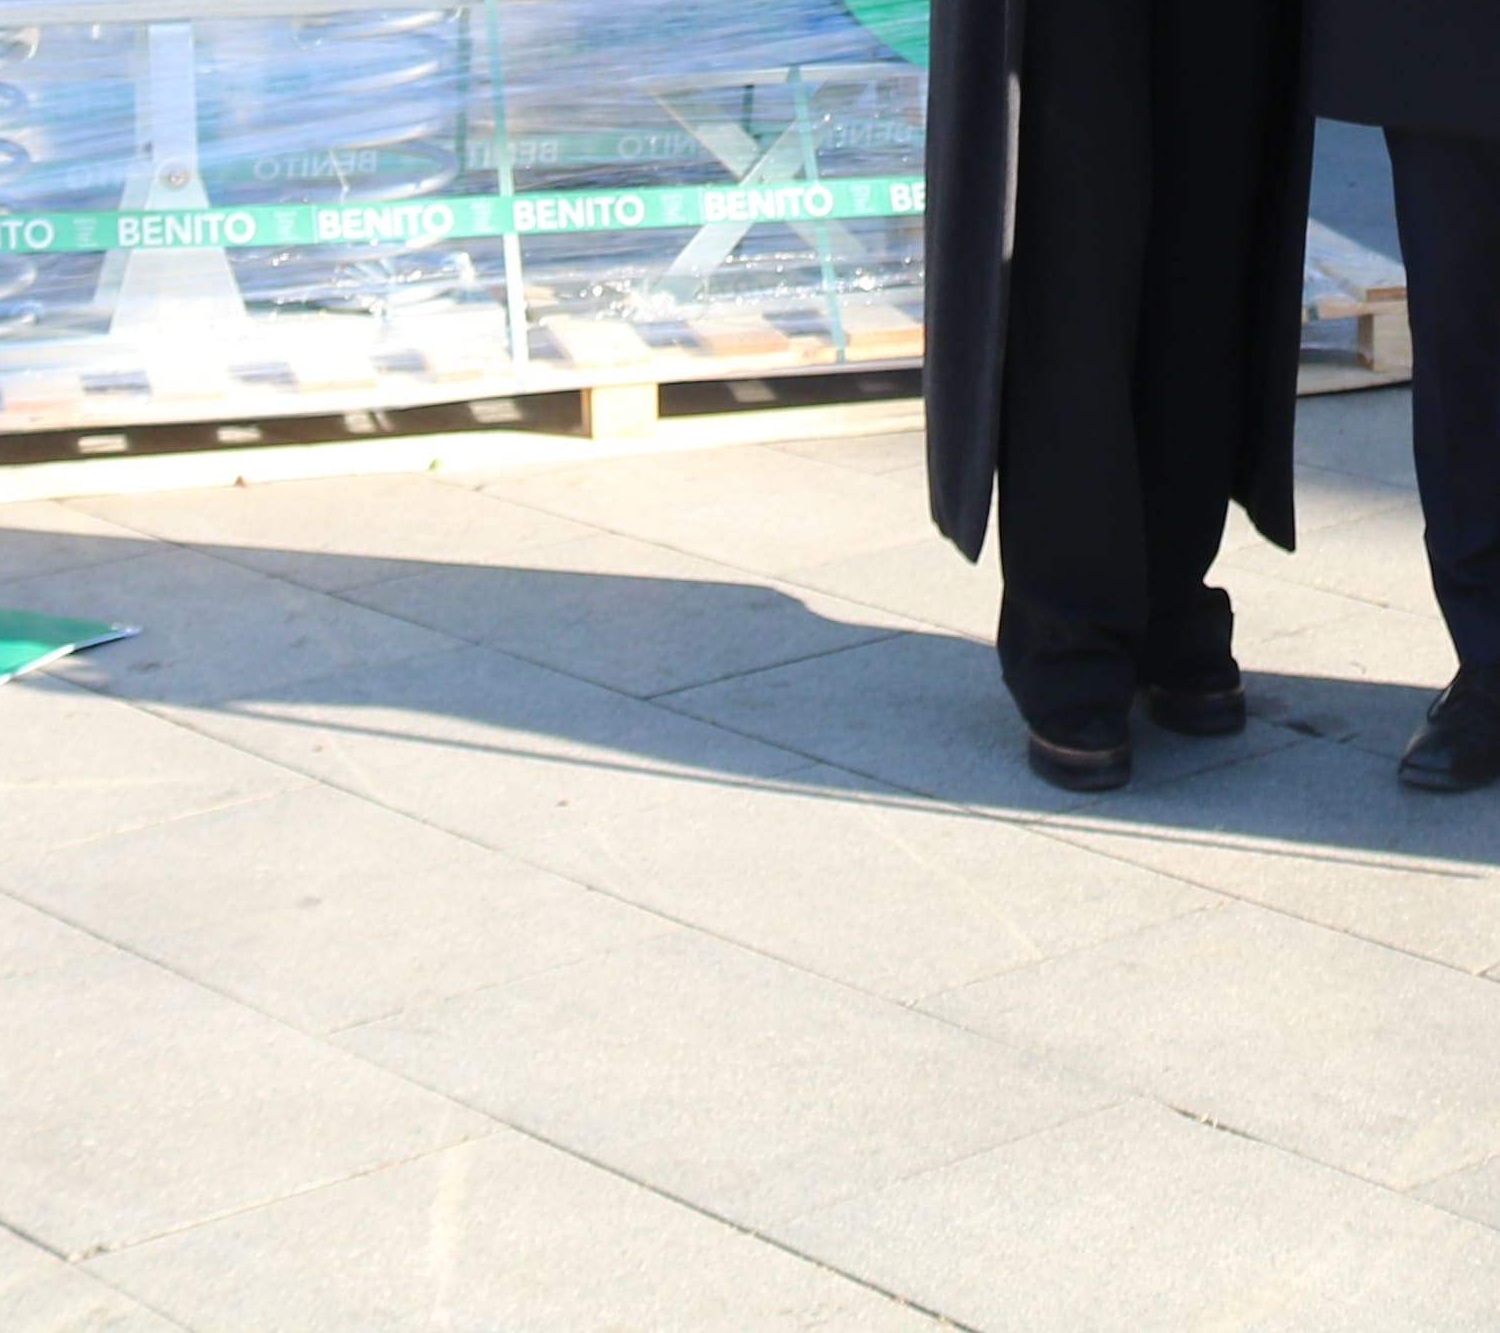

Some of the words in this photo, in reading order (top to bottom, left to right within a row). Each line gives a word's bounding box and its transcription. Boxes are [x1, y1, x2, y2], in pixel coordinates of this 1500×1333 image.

[118, 212, 256, 247] BENITO
[319, 205, 455, 240] BENITO
[512, 194, 646, 231] BENITO
[703, 184, 834, 221] BENITO
